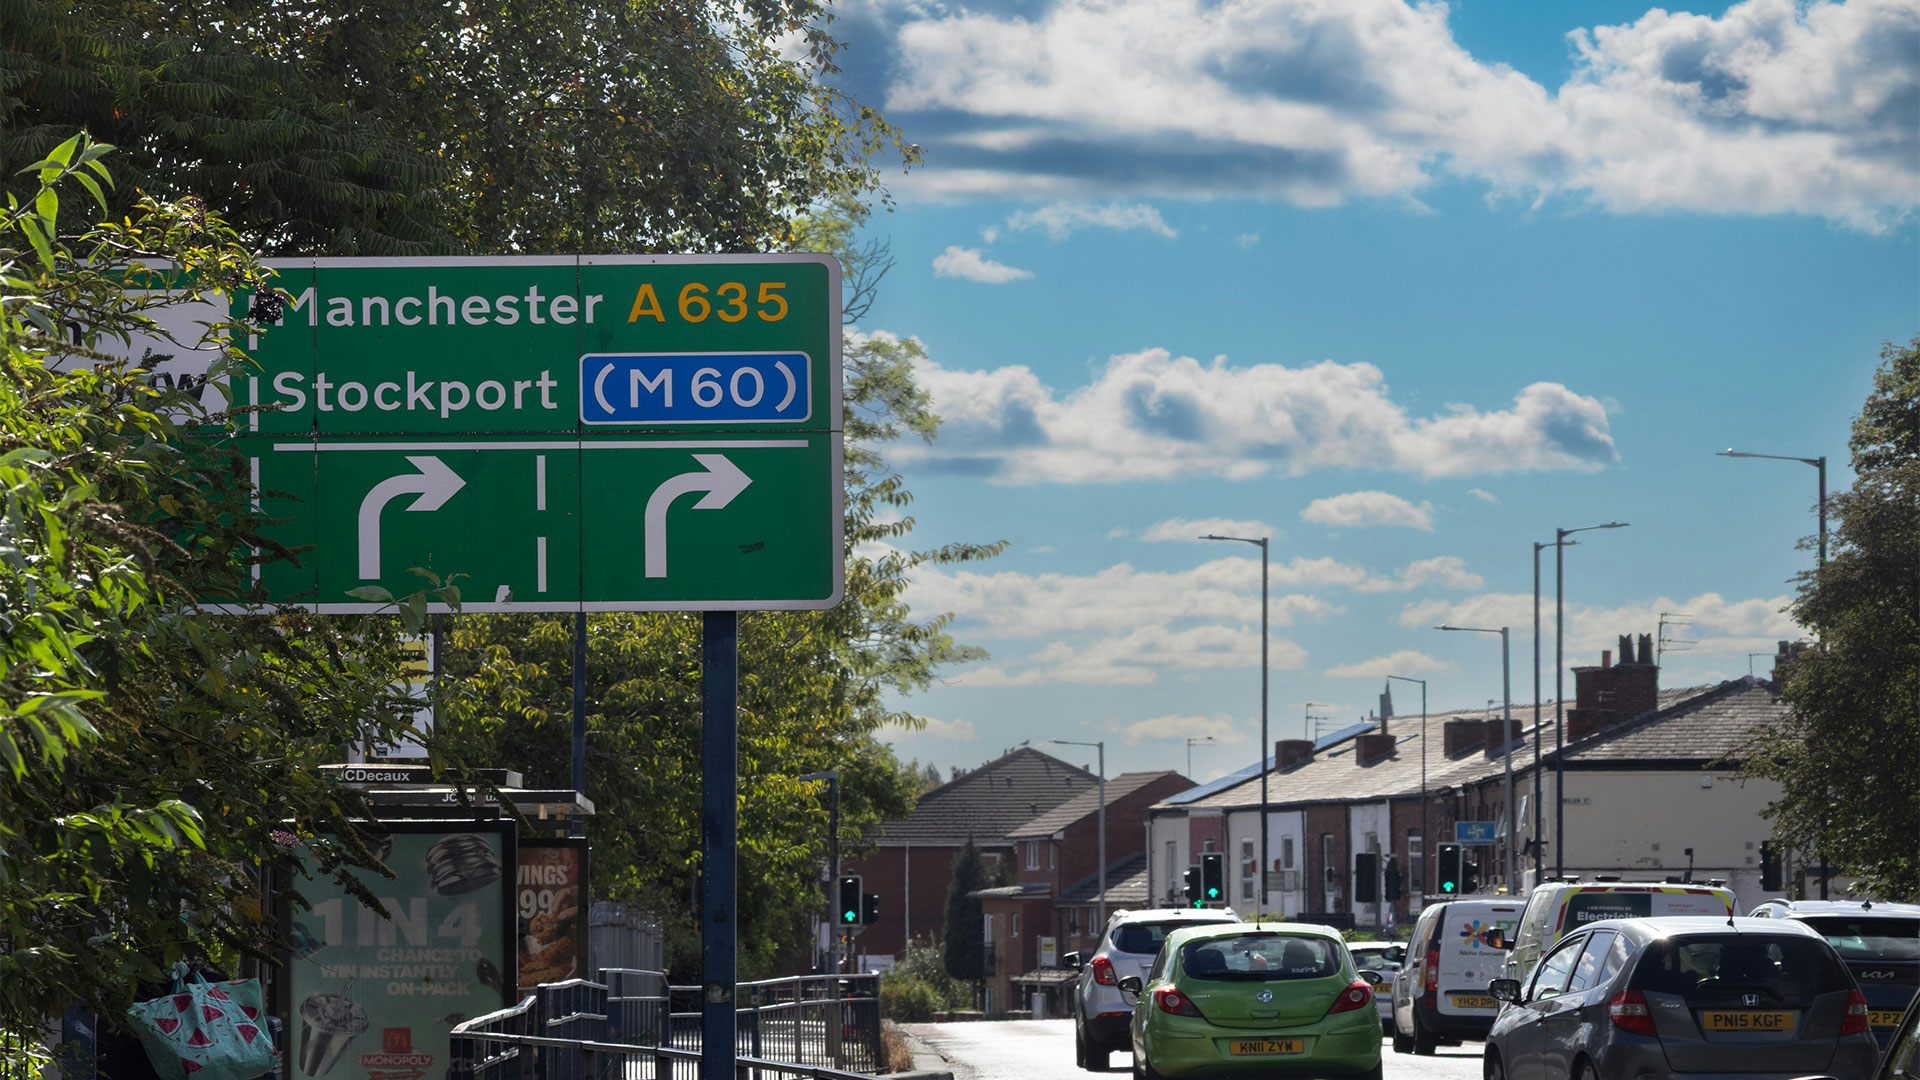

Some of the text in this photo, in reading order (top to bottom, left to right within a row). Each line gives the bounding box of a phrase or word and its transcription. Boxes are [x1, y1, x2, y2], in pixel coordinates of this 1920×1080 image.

[274, 285, 604, 327] Manchester
[272, 370, 558, 419] Stockport
[313, 897, 482, 946] 1 IN 4
[1577, 912, 1641, 921] Electricit
[377, 949, 483, 962] CHANCE TO
[321, 965, 458, 978] WIN INSTANTLY
[386, 982, 471, 996] ON-PACK
[1713, 1014, 1784, 1027] PN15 KGF
[1883, 1012, 1904, 1024] PZ
[1240, 1041, 1293, 1053] KN11 ZYW
[363, 1056, 431, 1065] MONOPOLY
